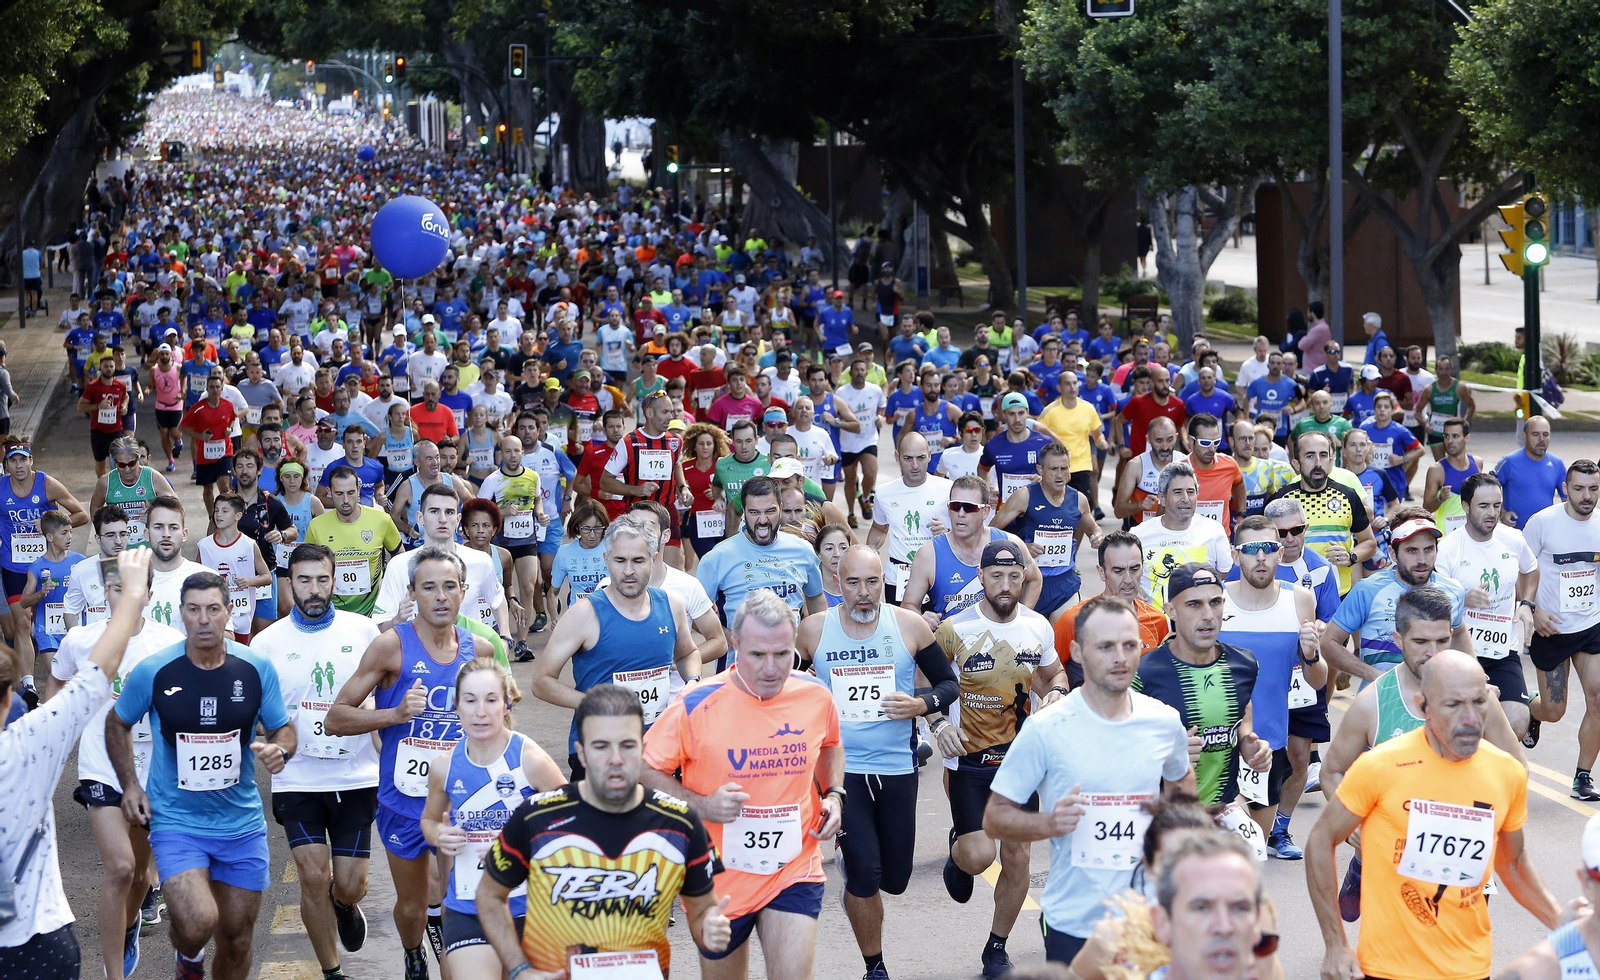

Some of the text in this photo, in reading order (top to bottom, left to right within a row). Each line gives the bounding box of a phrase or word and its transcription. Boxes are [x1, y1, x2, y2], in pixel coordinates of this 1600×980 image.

[421, 212, 449, 238] Forus
[393, 454, 406, 462] 320
[475, 454, 488, 462] 318
[1372, 452, 1388, 460] 012
[648, 460, 664, 469] 176
[8, 508, 41, 522] RCM
[127, 525, 138, 534] 38
[509, 520, 530, 529] 1044
[703, 519, 723, 529] 1089
[15, 543, 45, 553] 18223
[1042, 544, 1066, 555] 1828
[343, 572, 357, 583] 80
[572, 572, 606, 584] nerja
[1568, 584, 1595, 599] 3922
[944, 593, 985, 602] CLUB DEPO
[1467, 611, 1476, 619] 41
[1468, 627, 1508, 646] 17800
[826, 646, 879, 664] nerja
[832, 668, 843, 677] 41
[972, 664, 993, 672] SANTO
[615, 674, 627, 683] 41
[847, 685, 881, 702] 275
[301, 701, 312, 710] 41
[408, 719, 466, 740] 1873
[414, 739, 441, 748] CARRERA
[727, 742, 807, 771] V MEDIA 2018
[749, 753, 807, 770] MARATÓN
[188, 754, 233, 771] 1285
[741, 805, 798, 815] CARRERA URBANA
[1414, 801, 1493, 820] 41 CARRERA URBANA
[1094, 821, 1135, 841] 344
[743, 831, 784, 849] 357
[1415, 831, 1486, 861] 17672
[541, 861, 660, 907] TEBA
[570, 895, 660, 921] RUNNING
[574, 957, 590, 968] 41
